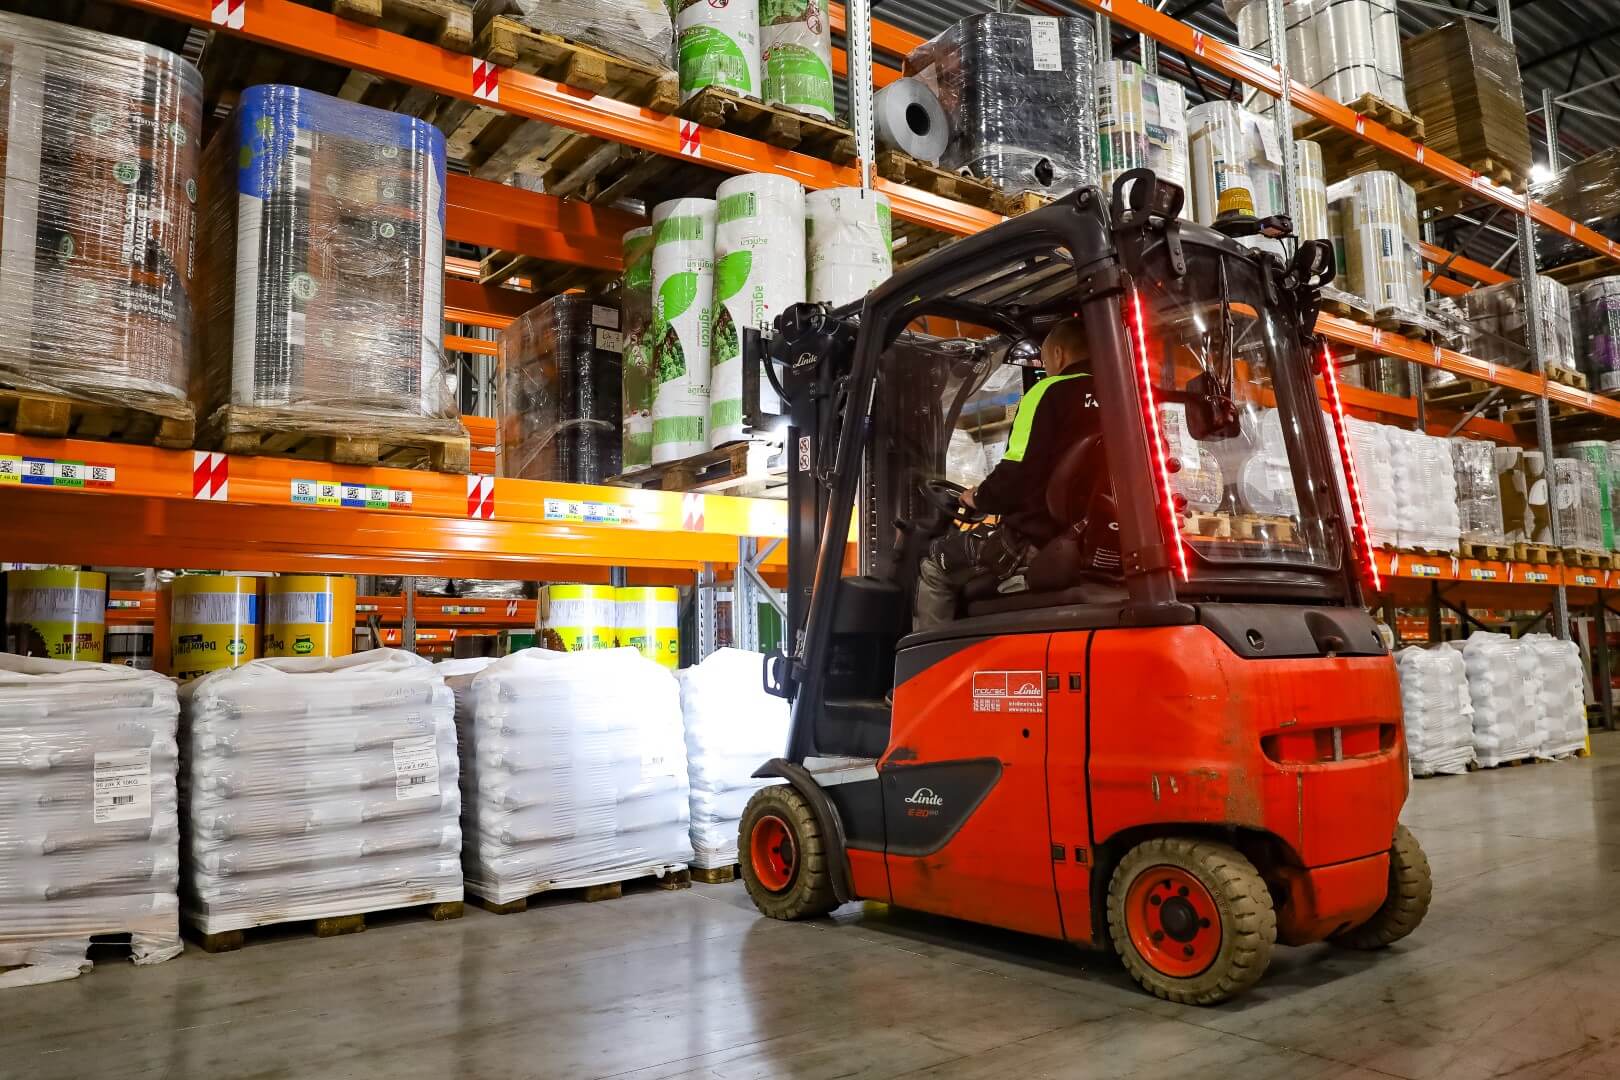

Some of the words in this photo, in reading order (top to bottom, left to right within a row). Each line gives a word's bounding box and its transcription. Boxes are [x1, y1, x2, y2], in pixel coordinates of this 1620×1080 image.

[792, 352, 817, 369] Linde
[1013, 682, 1041, 695] Linde
[904, 787, 943, 806] Linde
